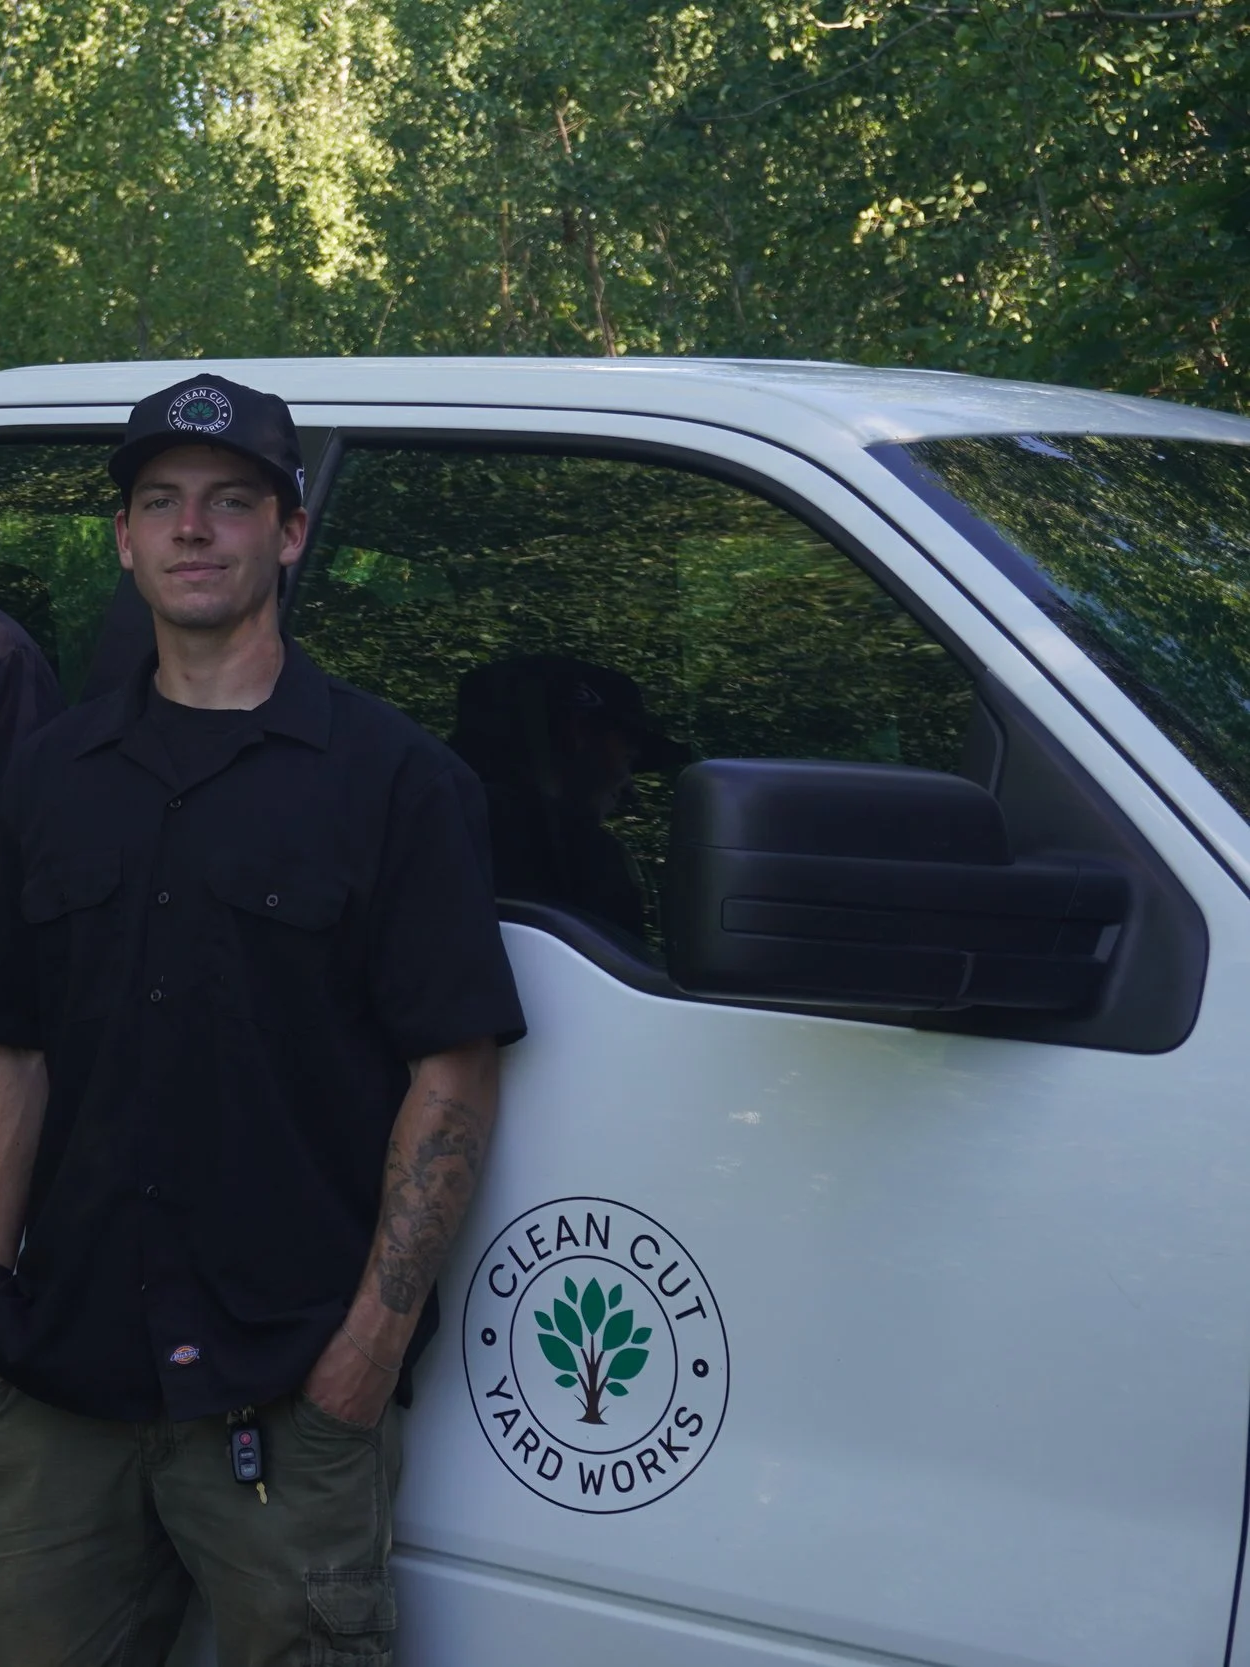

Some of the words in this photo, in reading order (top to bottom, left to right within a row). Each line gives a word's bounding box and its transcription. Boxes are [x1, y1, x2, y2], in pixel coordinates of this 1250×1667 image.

[175, 389, 207, 408] CLEAN
[209, 392, 228, 408] CUT
[488, 1212, 611, 1299] CLEAN
[629, 1234, 708, 1321] CUT
[485, 1375, 563, 1481] YARD
[578, 1406, 704, 1496] WORKS
